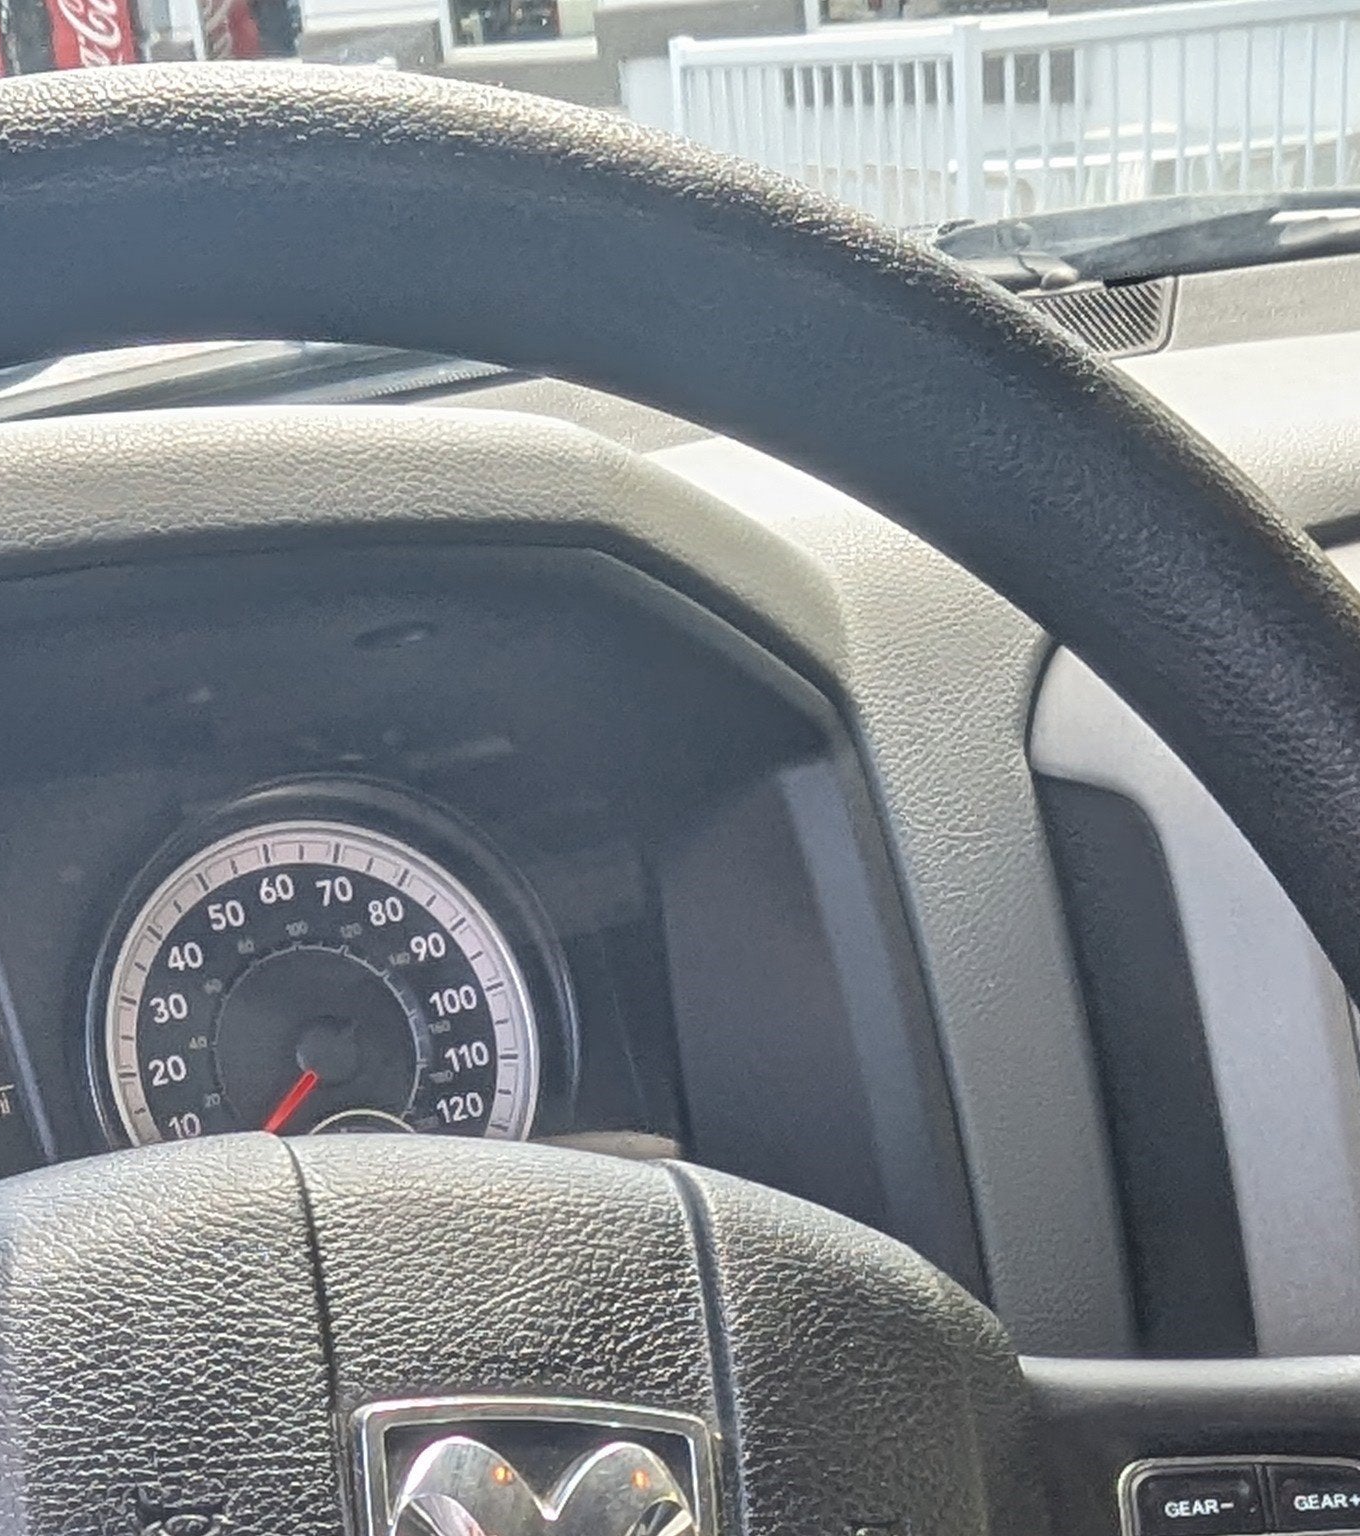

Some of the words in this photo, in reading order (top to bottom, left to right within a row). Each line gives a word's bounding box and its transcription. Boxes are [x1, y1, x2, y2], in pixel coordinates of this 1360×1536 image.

[259, 874, 295, 905] 60
[316, 876, 353, 906] 70
[208, 899, 246, 932] 50
[369, 897, 405, 927] 80
[167, 942, 204, 973] 40
[410, 932, 446, 961] 90
[149, 993, 188, 1026] 30
[429, 984, 479, 1016] 100
[148, 1055, 188, 1087] 20
[444, 1041, 490, 1074] 110
[436, 1093, 484, 1125] 120
[169, 1113, 202, 1140] 10
